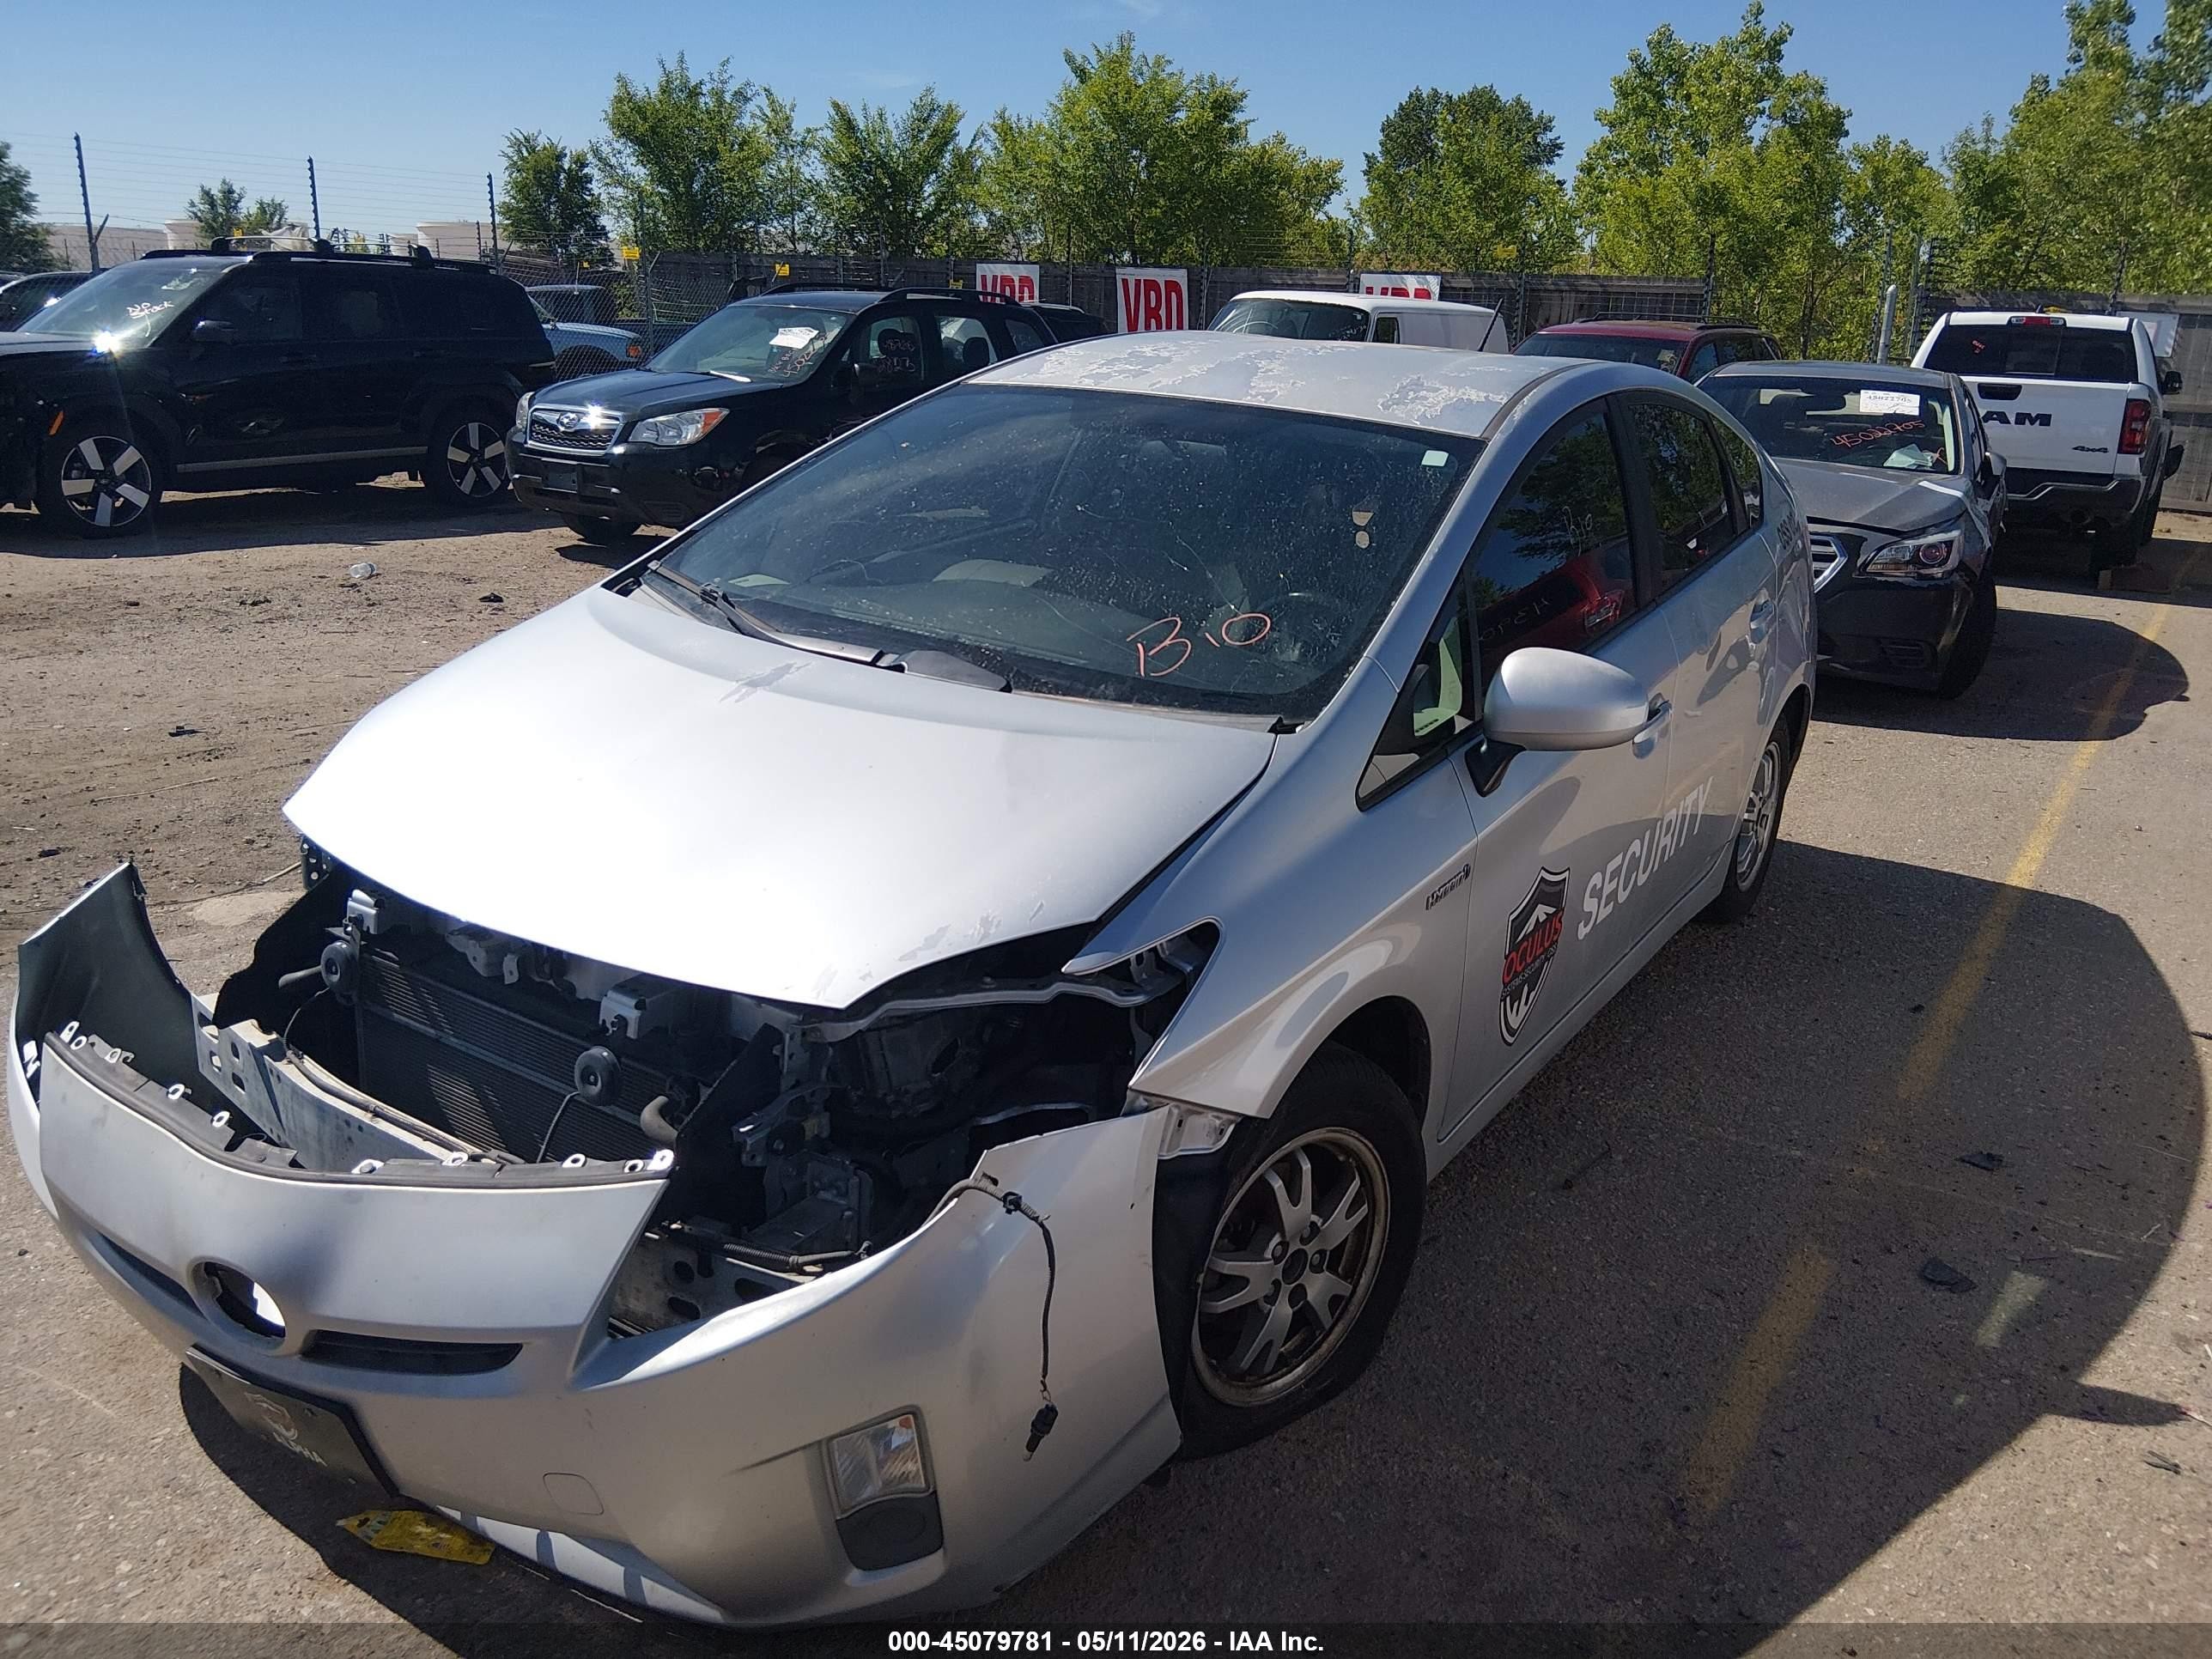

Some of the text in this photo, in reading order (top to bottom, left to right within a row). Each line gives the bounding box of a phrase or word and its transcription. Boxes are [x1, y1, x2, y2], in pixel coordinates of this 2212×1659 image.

[1982, 410, 2052, 427] AM
[2072, 445, 2109, 453] 4x4
[1577, 775, 1714, 940] SECURITY
[1503, 912, 1563, 984] OCULUS
